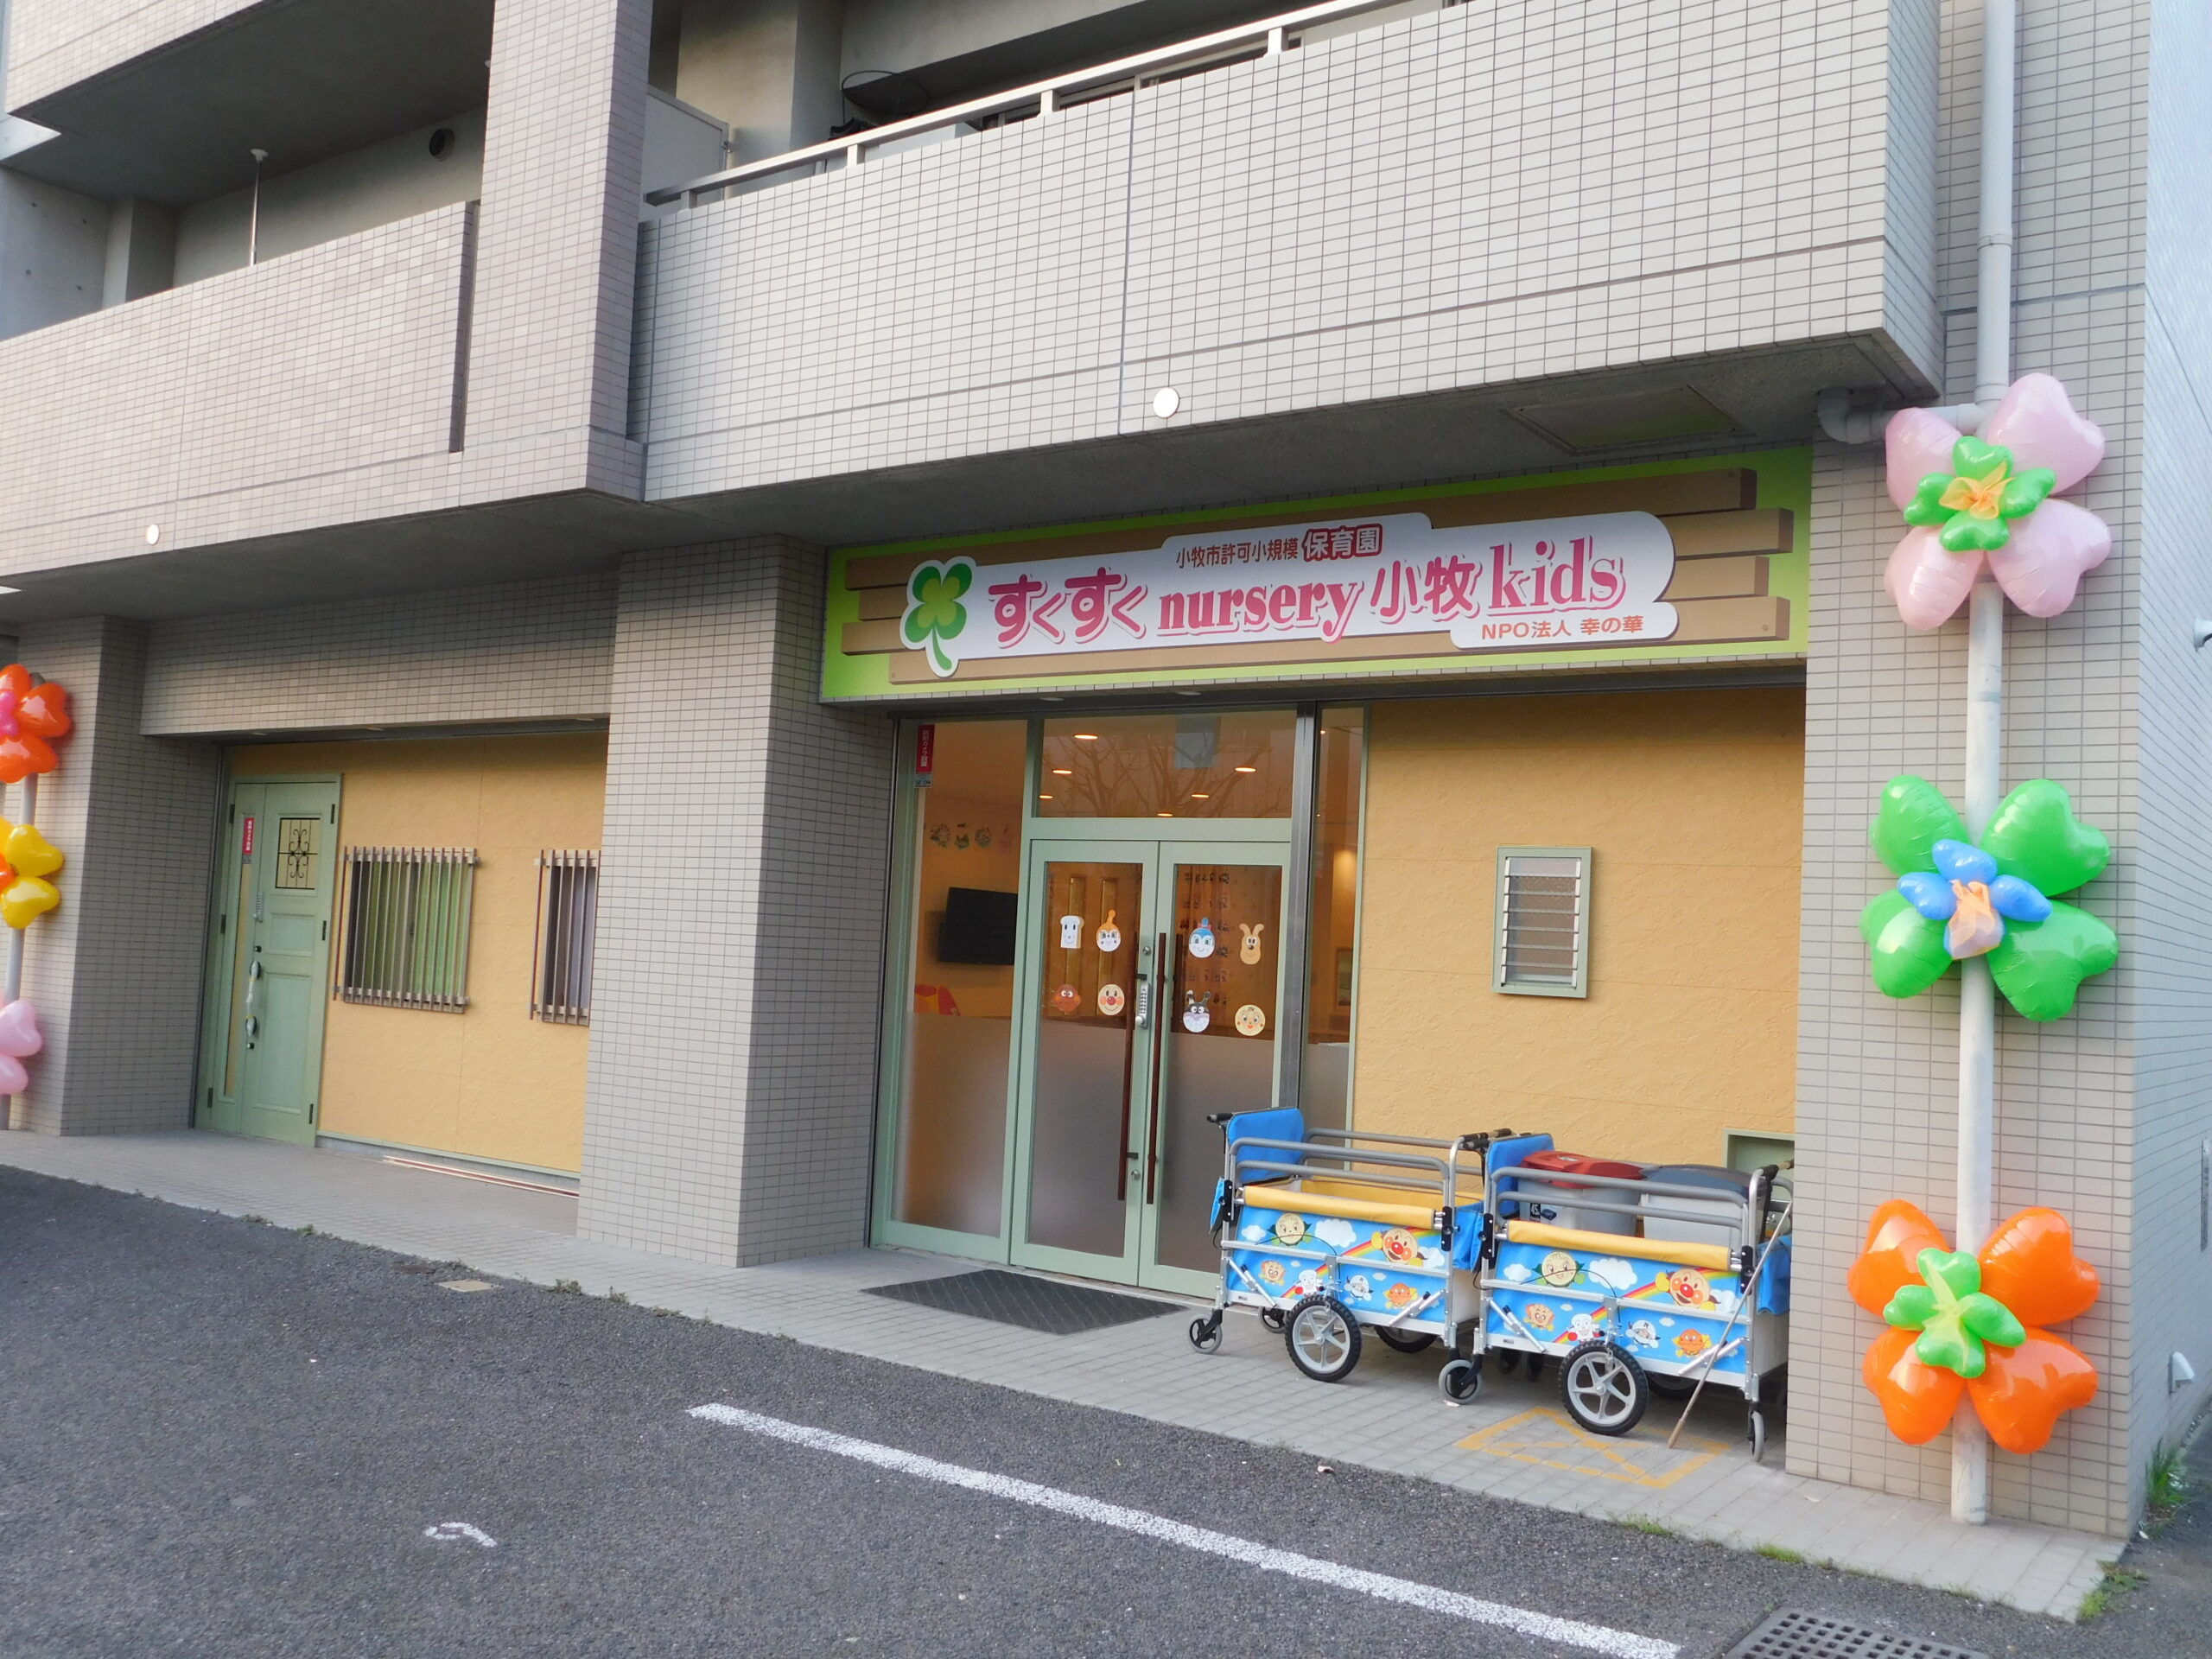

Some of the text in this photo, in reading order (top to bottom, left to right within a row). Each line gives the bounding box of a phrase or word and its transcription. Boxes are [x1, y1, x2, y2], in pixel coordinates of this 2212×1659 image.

[1176, 524, 1382, 569] 小牧市許可小規模 保育園
[988, 536, 1621, 646] すくすく nursery 小牧 kids
[1482, 614, 1643, 639] NPO法人 幸の華
